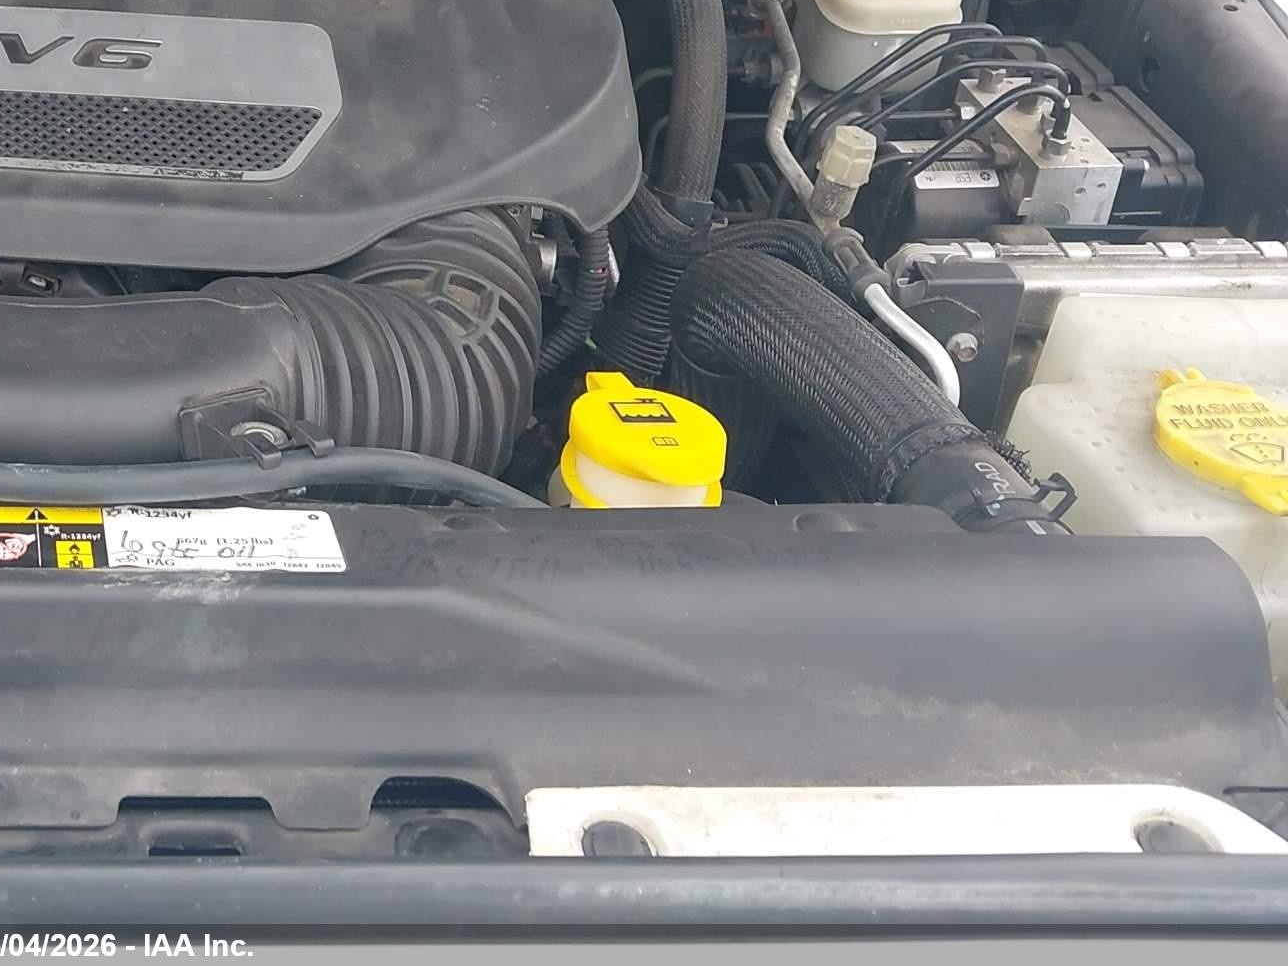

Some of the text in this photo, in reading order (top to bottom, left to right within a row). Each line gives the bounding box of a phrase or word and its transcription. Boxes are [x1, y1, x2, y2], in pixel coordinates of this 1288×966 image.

[1171, 401, 1270, 416] WASHER
[1169, 417, 1234, 430] FLUID
[975, 461, 1016, 496] RAD
[146, 557, 175, 567] PAG
